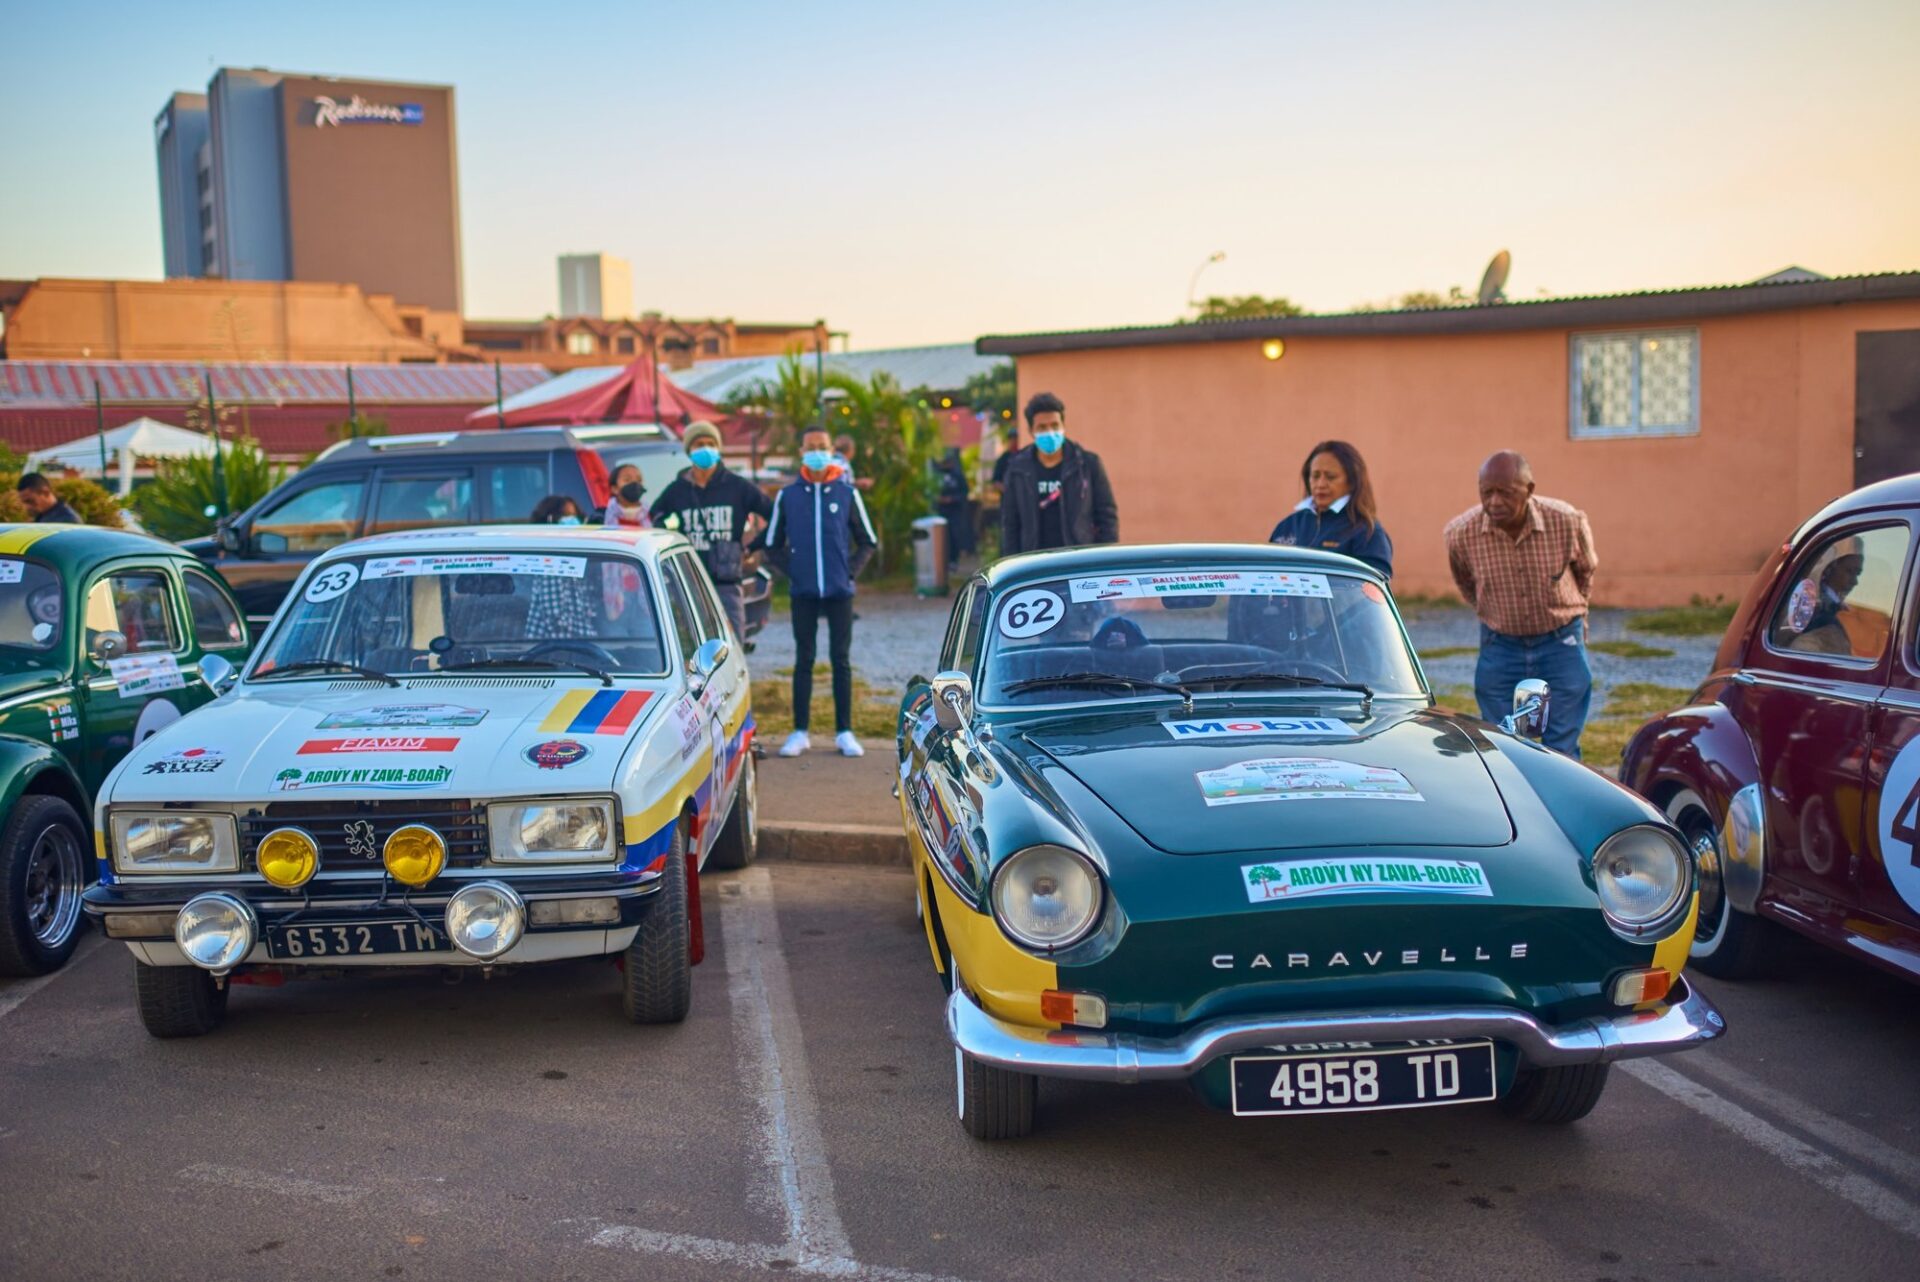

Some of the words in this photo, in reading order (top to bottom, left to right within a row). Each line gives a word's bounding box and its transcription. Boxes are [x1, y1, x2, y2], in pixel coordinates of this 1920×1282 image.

[311, 571, 351, 595] 53
[1152, 576, 1187, 584] RALLYE
[1007, 597, 1055, 629] 62
[1174, 720, 1333, 735] Mobil
[338, 738, 427, 749] FIAMM
[305, 769, 350, 783] AROVY
[351, 769, 367, 782] NY
[370, 768, 452, 782] ZAVA-BOARY
[1289, 864, 1346, 887] AROVY
[1350, 864, 1372, 883] NY
[1379, 863, 1483, 886] ZAVA-BOARY
[286, 926, 374, 956] 6532
[392, 924, 436, 951] TM
[1212, 943, 1527, 969] CARAVELLE
[1270, 1059, 1379, 1106] 4958
[1408, 1053, 1459, 1098] TD
